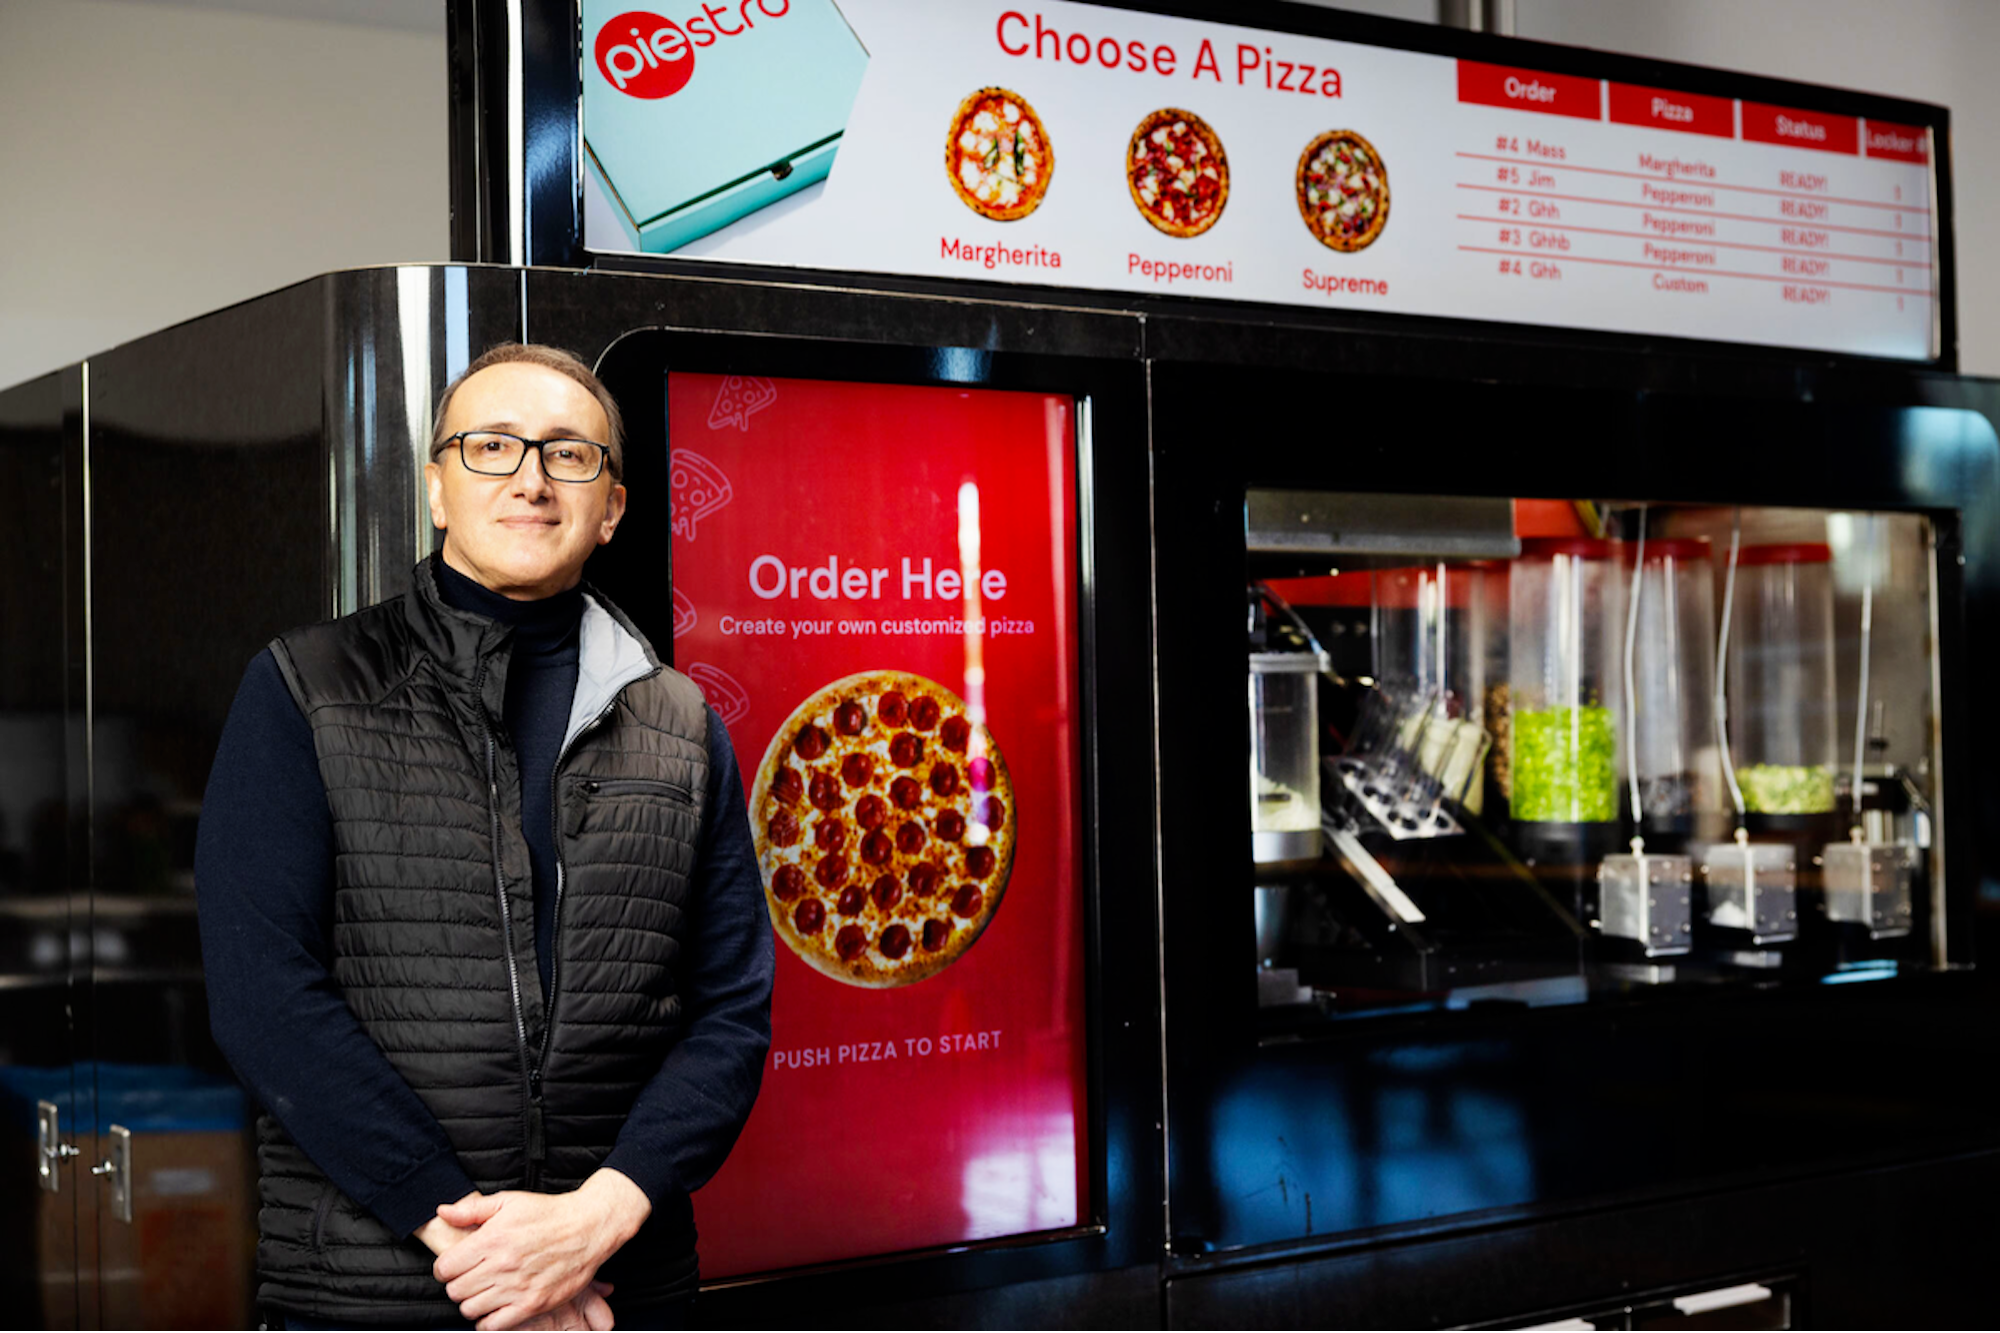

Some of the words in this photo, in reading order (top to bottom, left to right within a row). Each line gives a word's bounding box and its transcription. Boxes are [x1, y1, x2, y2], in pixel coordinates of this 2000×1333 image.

[605, 0, 790, 89] piestro
[997, 11, 1176, 76] Choose
[1192, 38, 1222, 82] A
[1237, 44, 1343, 98] Pizza
[1504, 76, 1556, 103] Order
[1651, 97, 1694, 123] Pizza
[1775, 114, 1826, 140] Status
[1496, 136, 1519, 153] #4
[1527, 138, 1566, 160] Mass
[1638, 153, 1716, 179] Margherita
[1779, 170, 1828, 192] READY!
[1497, 167, 1520, 185] #5
[1528, 170, 1556, 188] Jim
[1642, 183, 1715, 207] Pepperoni
[1780, 199, 1828, 220] READY!
[1498, 198, 1520, 216] #2
[1529, 200, 1560, 220] Ghh
[1642, 213, 1716, 236] Pepperoni
[1781, 228, 1829, 248] READY!
[942, 238, 1061, 269] Margherita
[1128, 253, 1233, 282] Pepperoni
[1498, 228, 1521, 246] #3
[1643, 242, 1716, 265] Pepperoni
[1782, 257, 1830, 277] READY!
[1302, 269, 1389, 295] Supreme
[1499, 259, 1522, 277] #4
[1530, 261, 1562, 280] Ghh
[1653, 273, 1708, 294] Custom
[1782, 285, 1830, 305] READY!
[749, 555, 888, 600] Order
[901, 556, 1007, 600] Here
[719, 616, 785, 635] Create
[791, 619, 833, 639] your
[838, 619, 877, 635] own
[882, 616, 985, 635] customized
[990, 616, 1035, 638] pizza
[773, 1047, 831, 1070] PUSH
[838, 1041, 898, 1063] PIZZA
[905, 1037, 933, 1057] TO
[939, 1030, 1002, 1053] START
